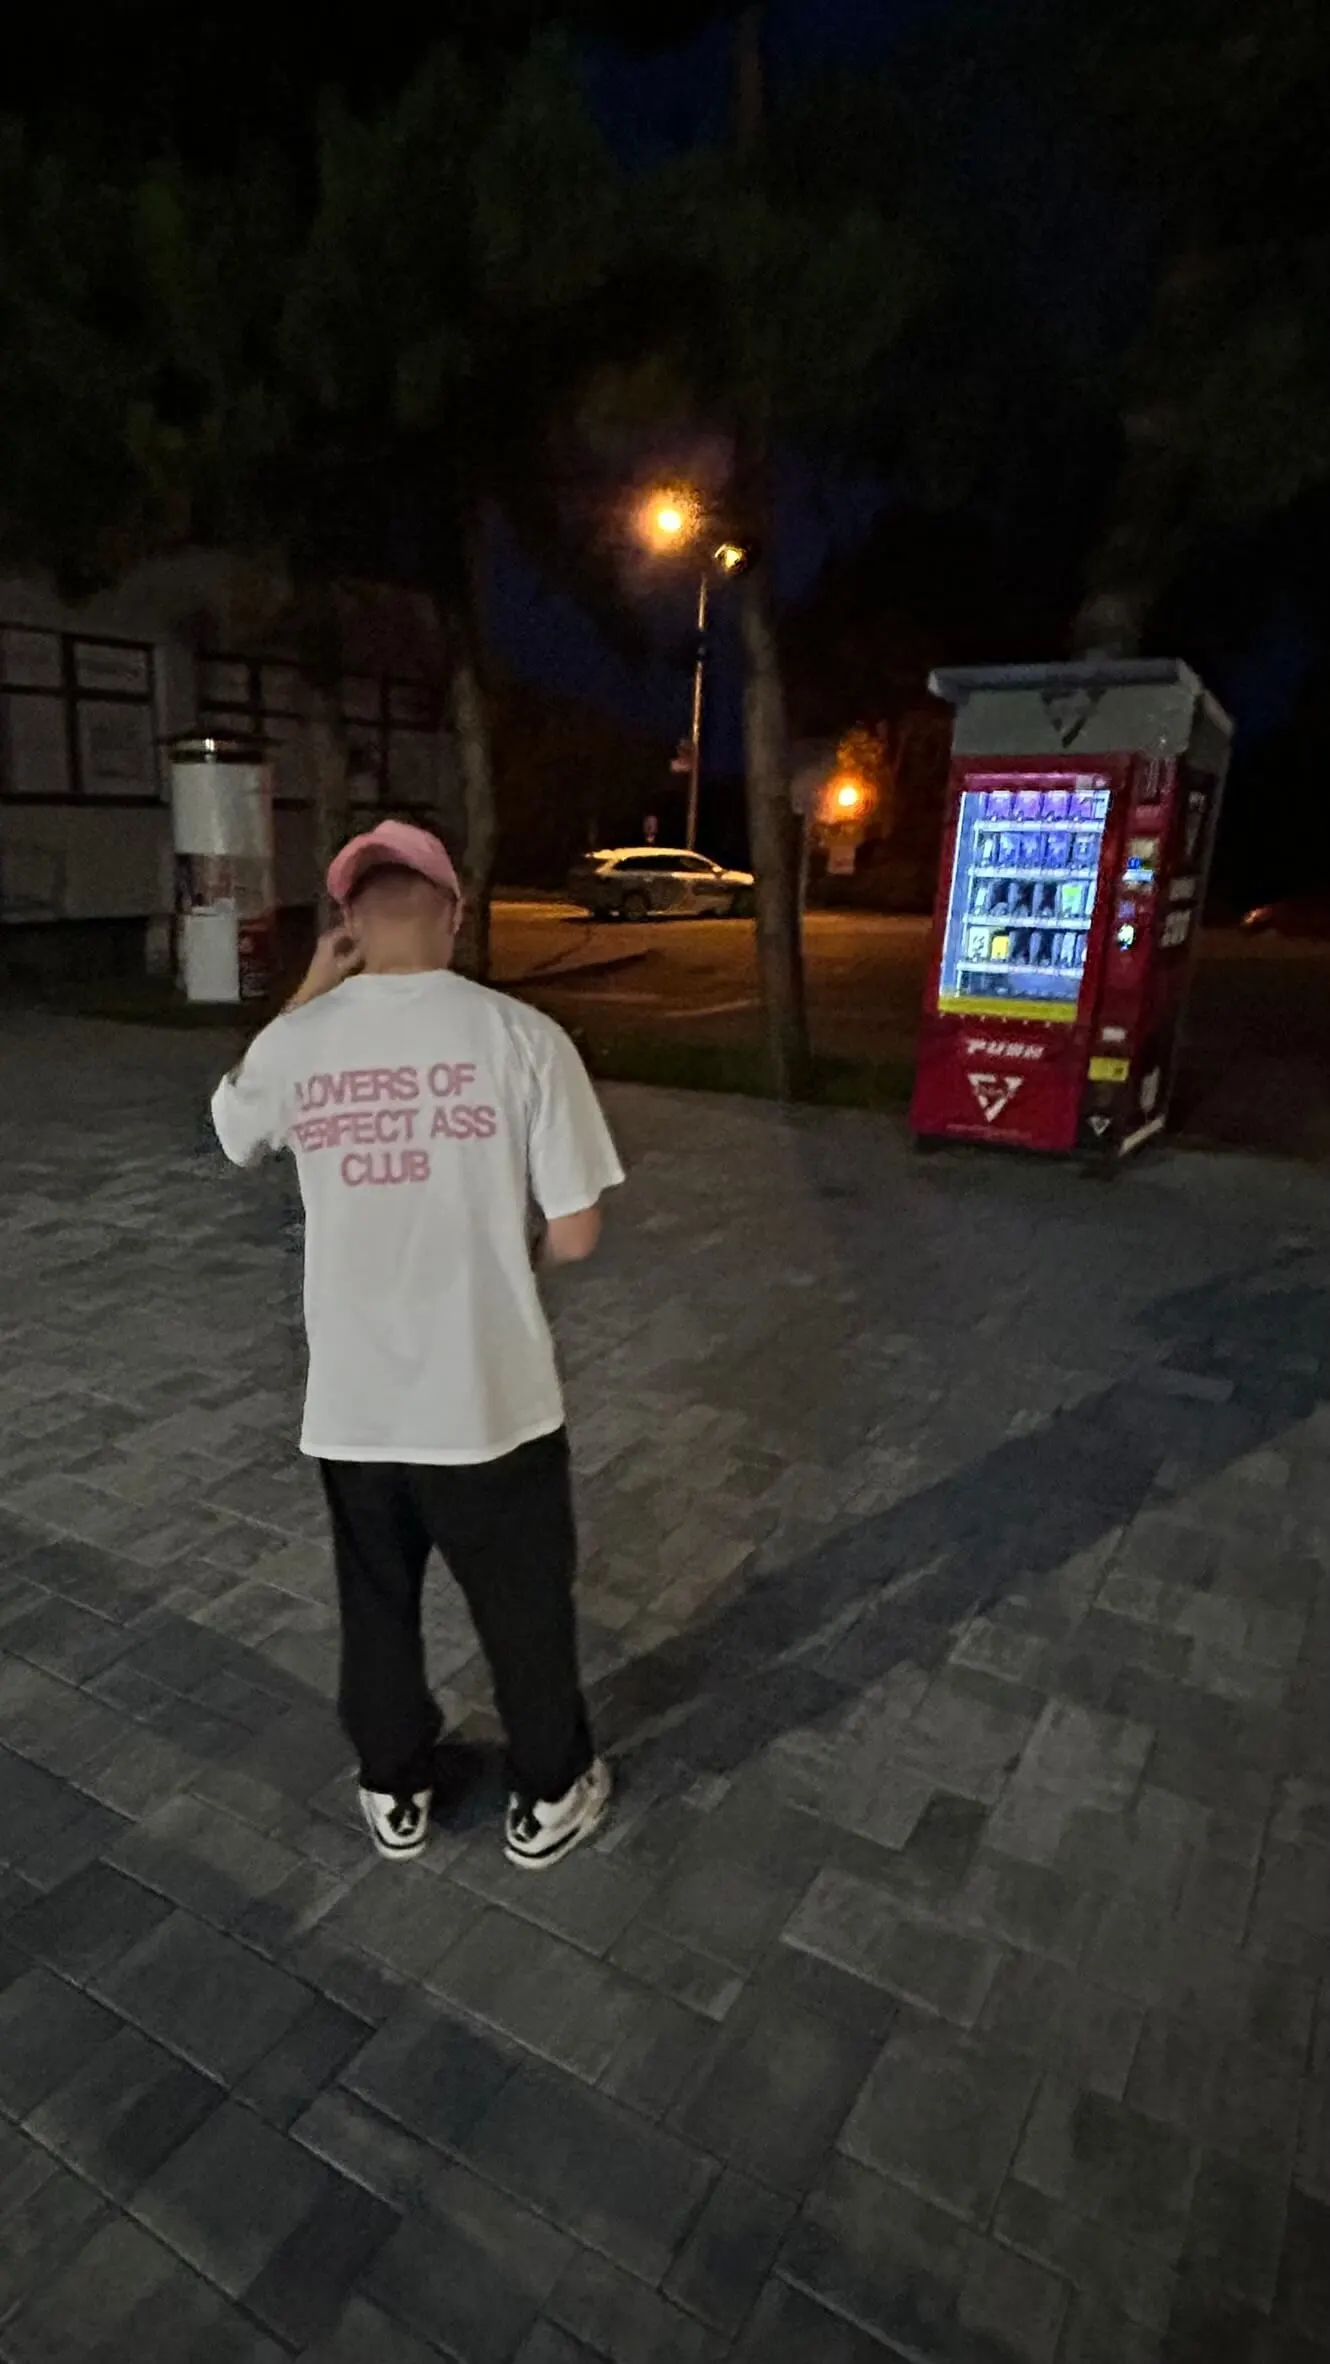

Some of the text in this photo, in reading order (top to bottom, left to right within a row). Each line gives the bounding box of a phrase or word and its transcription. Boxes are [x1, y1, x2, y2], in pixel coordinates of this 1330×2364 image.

[295, 1063, 476, 1111] LOVERS OF
[431, 1106, 496, 1139] ASS
[341, 1151, 431, 1186] CLUB
